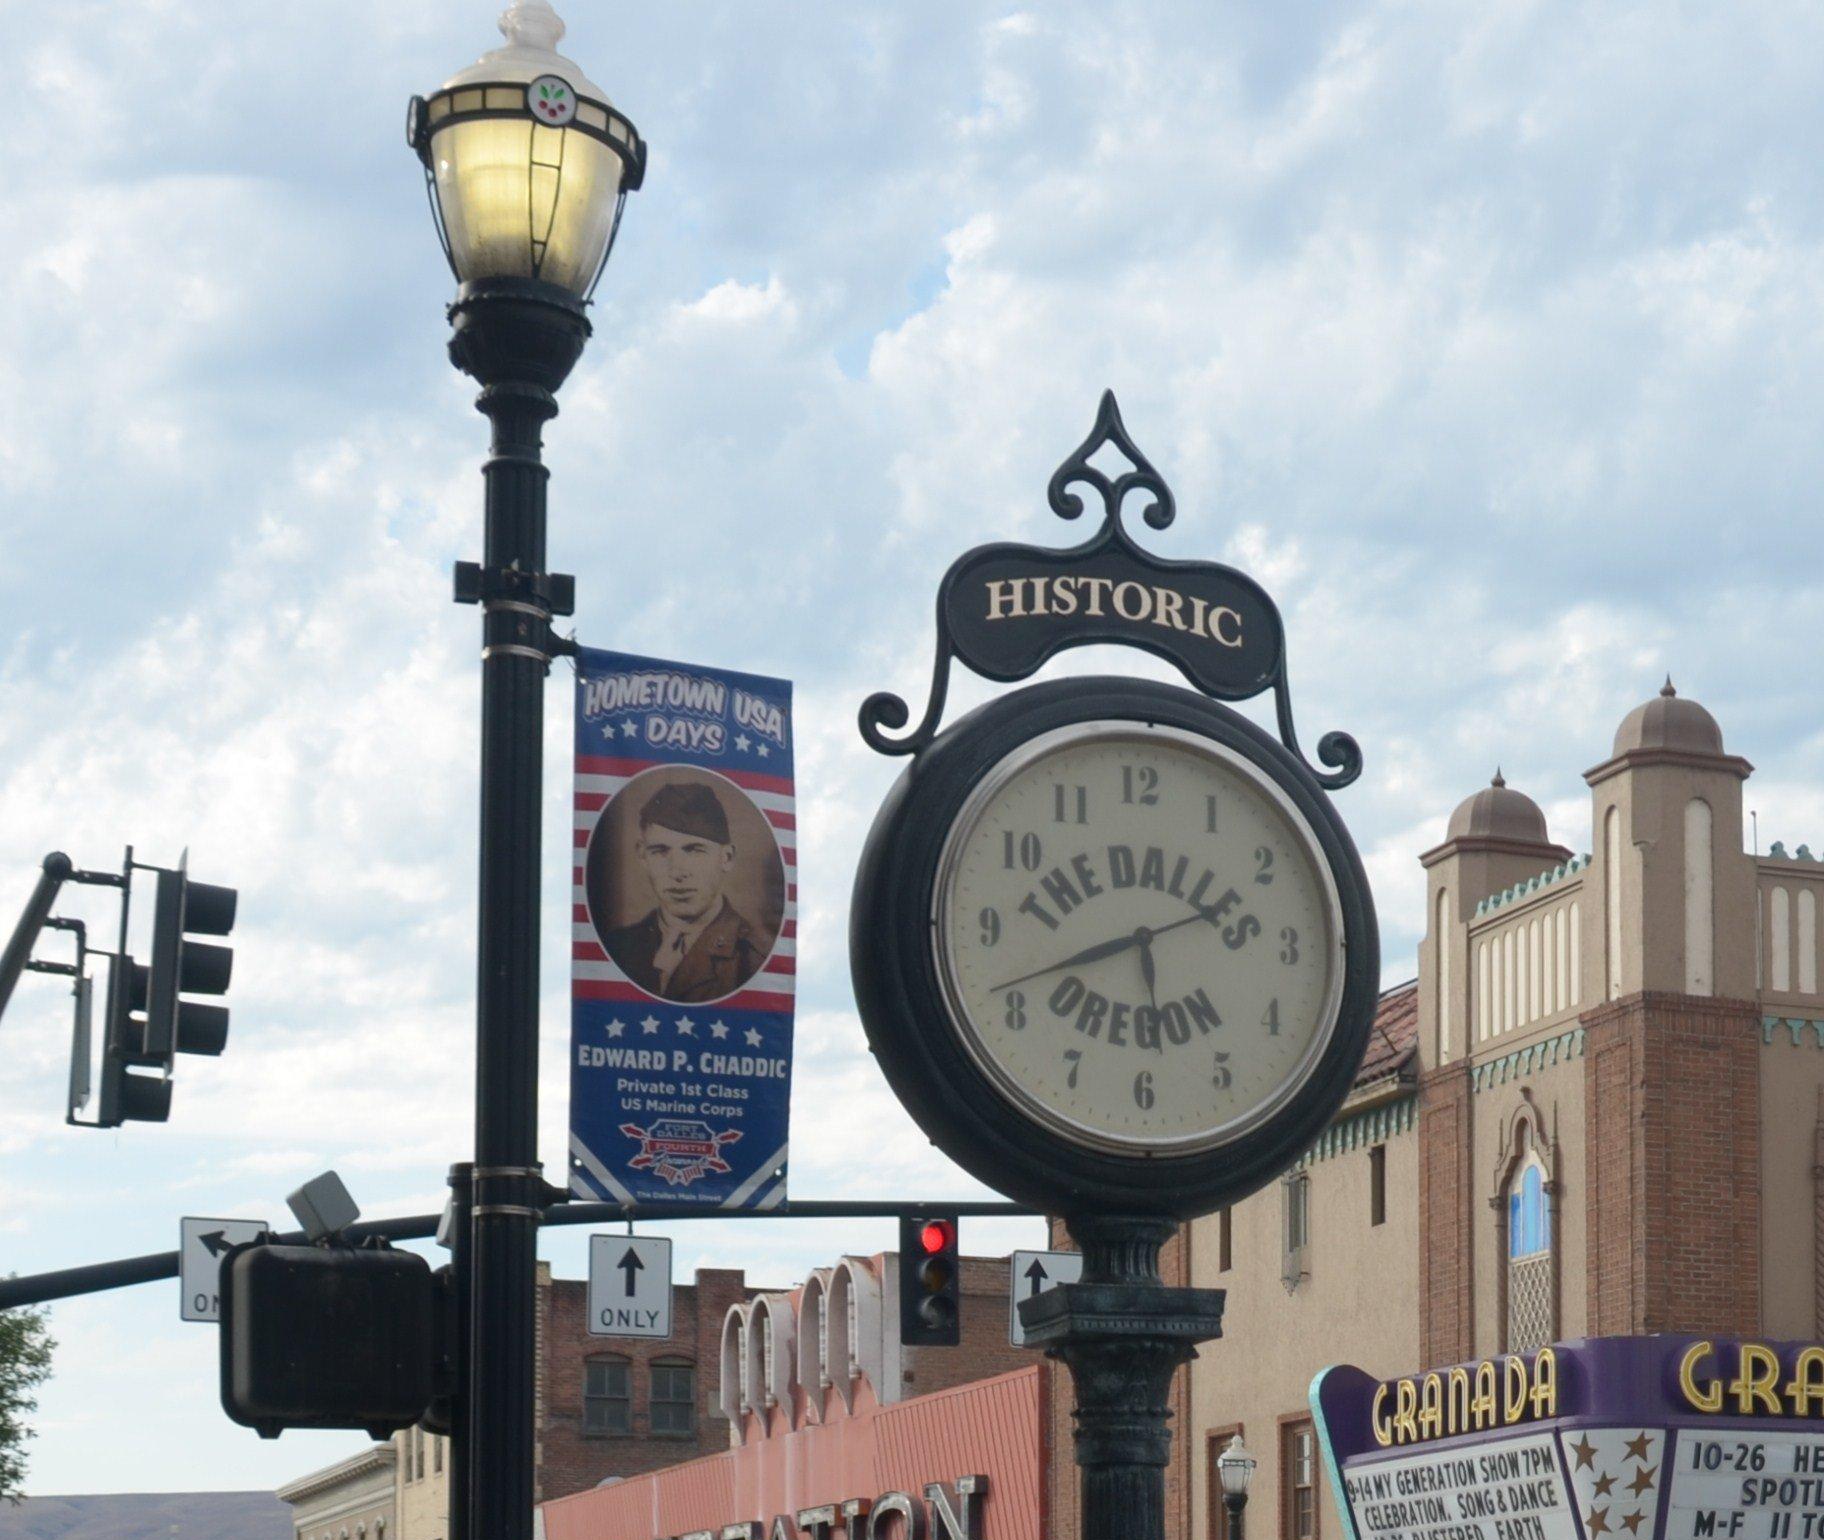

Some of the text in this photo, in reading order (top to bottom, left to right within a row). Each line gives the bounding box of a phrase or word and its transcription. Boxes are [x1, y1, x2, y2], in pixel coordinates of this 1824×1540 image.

[985, 576, 1243, 648] HISTORIC
[584, 672, 784, 743] HOMETOWN USA
[648, 716, 724, 750] DAYS
[1053, 784, 1090, 825] 11
[1120, 766, 1160, 806] 12
[1204, 796, 1219, 834] 1
[1003, 830, 1042, 871] 10
[1254, 846, 1274, 885] 2
[1018, 844, 1262, 951] THE DALLES
[979, 907, 1000, 947] 9
[1280, 926, 1300, 967] 3
[1005, 992, 1027, 1032] 8
[1048, 976, 1223, 1050] OREGON
[1260, 998, 1281, 1036] 4
[578, 1045, 787, 1078] EDWARD P. CHADDIC
[1064, 1050, 1083, 1089] 7
[1212, 1052, 1233, 1090] 5
[617, 1078, 749, 1100] Private 1st Class
[621, 1098, 744, 1118] US Marine Corps
[1133, 1070, 1156, 1110] 6
[655, 1142, 708, 1152] FOURTH
[665, 1123, 699, 1132] FORT
[601, 1308, 660, 1329] ONLY
[1371, 1347, 1556, 1447] GRANADA
[1346, 1446, 1555, 1504] 9-14 MY GENERATION SHOW 7PM
[1693, 1442, 1766, 1472] 10-26
[1364, 1479, 1558, 1532] CELEBRATION. SONG & DANCE
[1693, 1510, 1745, 1539] M-F
